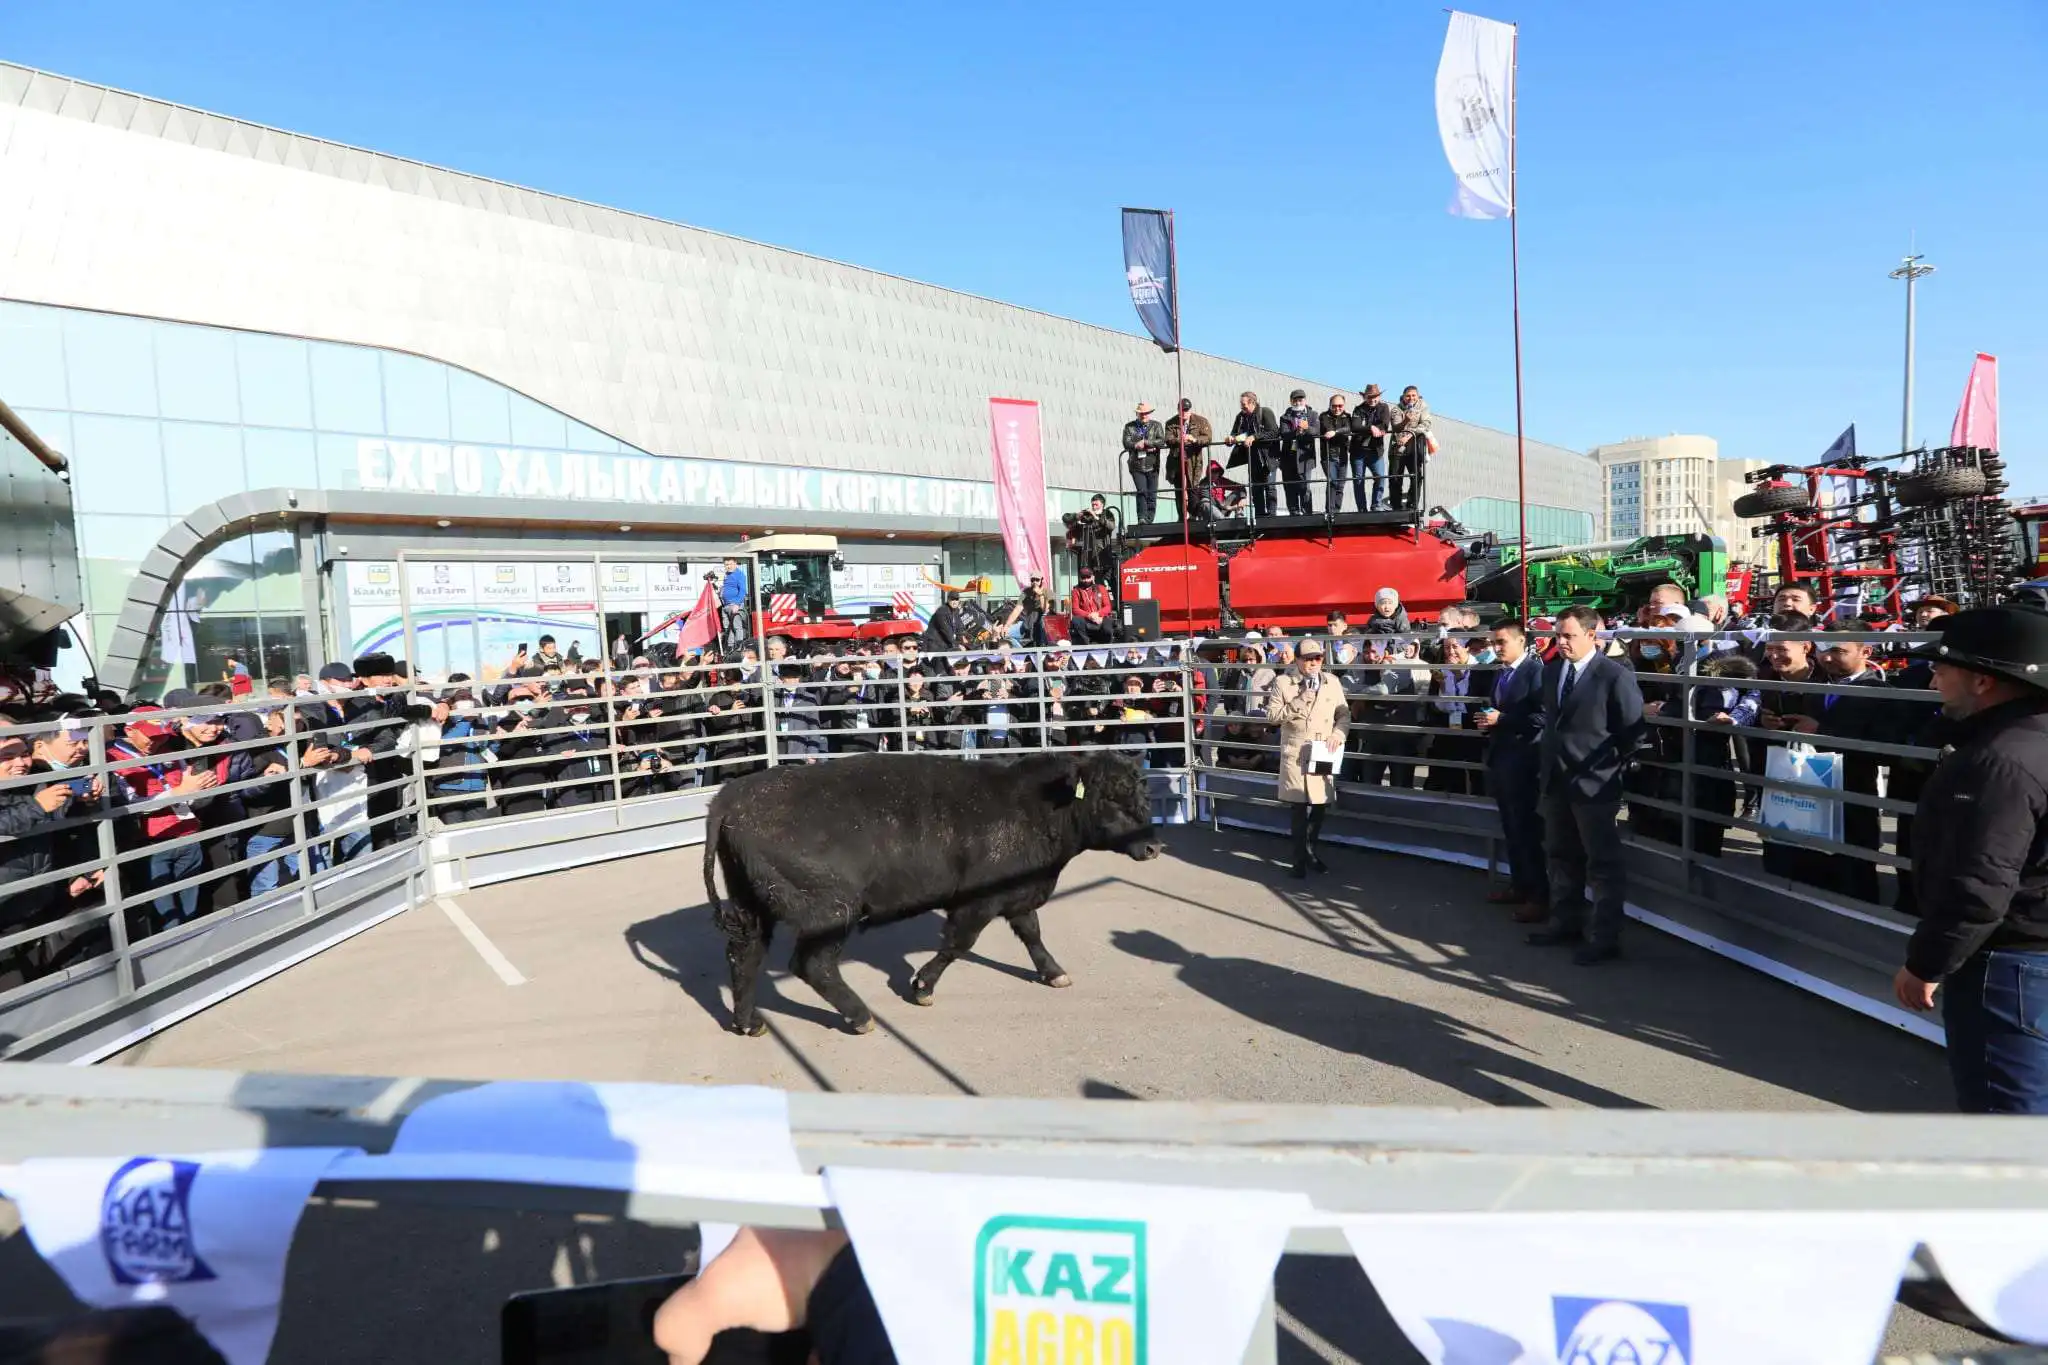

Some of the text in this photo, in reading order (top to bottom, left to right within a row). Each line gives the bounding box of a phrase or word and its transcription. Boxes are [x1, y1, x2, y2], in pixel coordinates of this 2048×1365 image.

[357, 439, 481, 494] EXPO
[108, 1187, 184, 1231] KAZ
[991, 1246, 1132, 1305] KAZ
[987, 1310, 1134, 1365] AGRO
